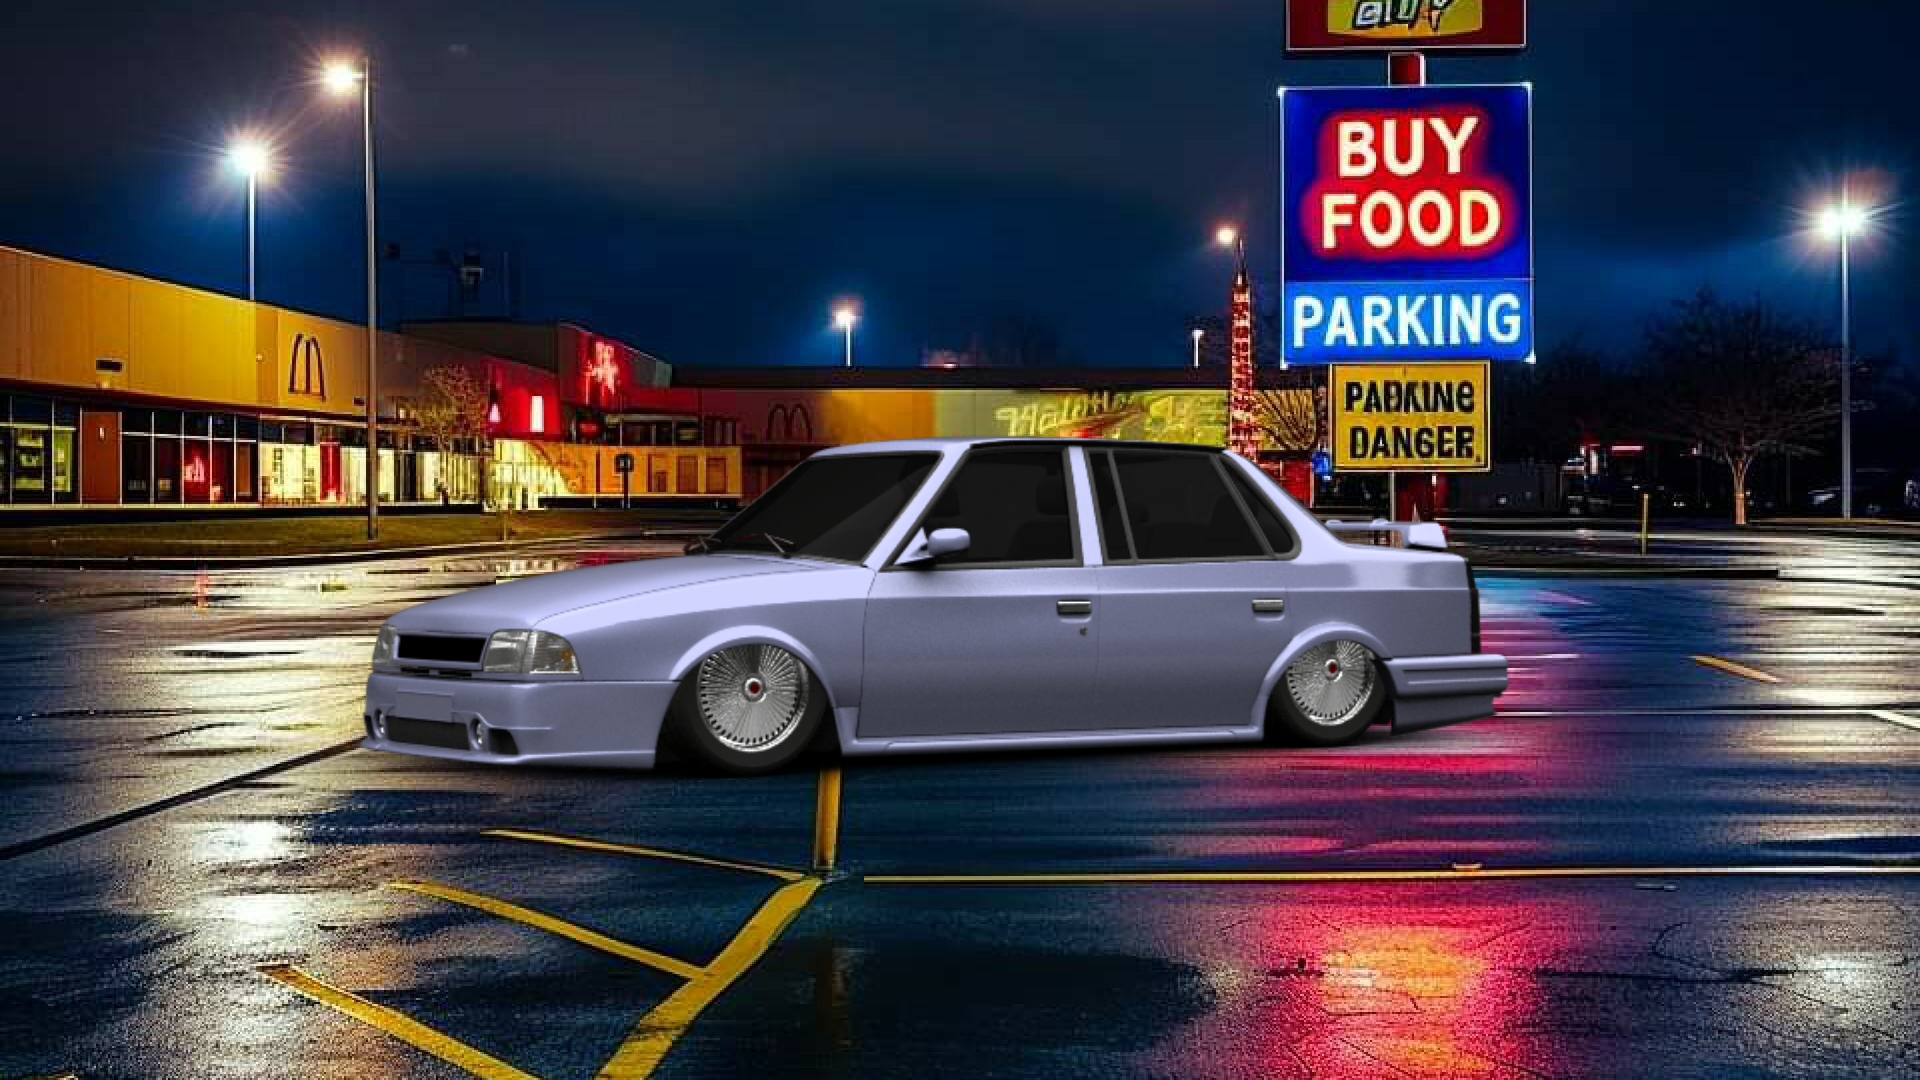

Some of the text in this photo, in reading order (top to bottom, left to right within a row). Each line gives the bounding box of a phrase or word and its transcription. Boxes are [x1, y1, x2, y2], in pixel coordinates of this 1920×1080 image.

[1337, 115, 1479, 178] BUY
[1321, 189, 1501, 249] FOOD
[1292, 292, 1522, 348] PARKING
